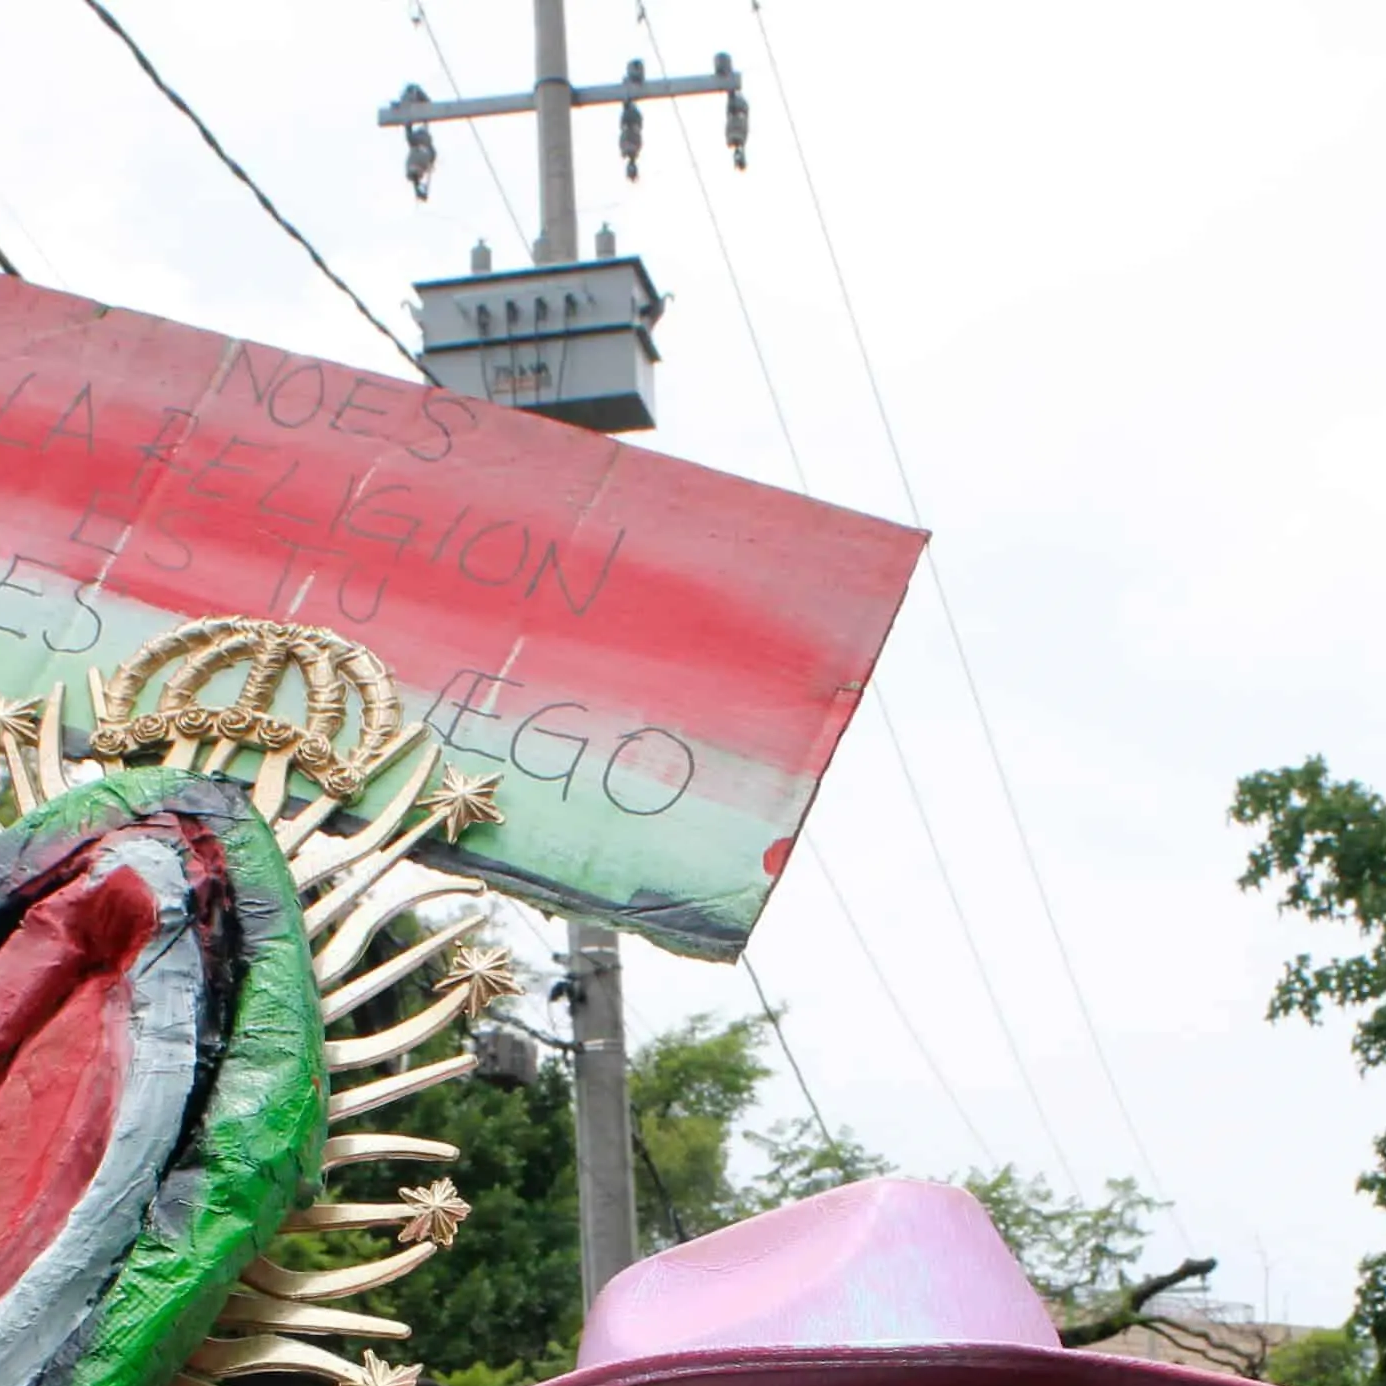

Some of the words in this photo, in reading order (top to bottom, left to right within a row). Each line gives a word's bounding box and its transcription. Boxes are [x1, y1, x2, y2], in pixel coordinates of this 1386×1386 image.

[69, 490, 208, 571] ES
[268, 532, 389, 623] TU
[131, 406, 627, 618] RELIGION
